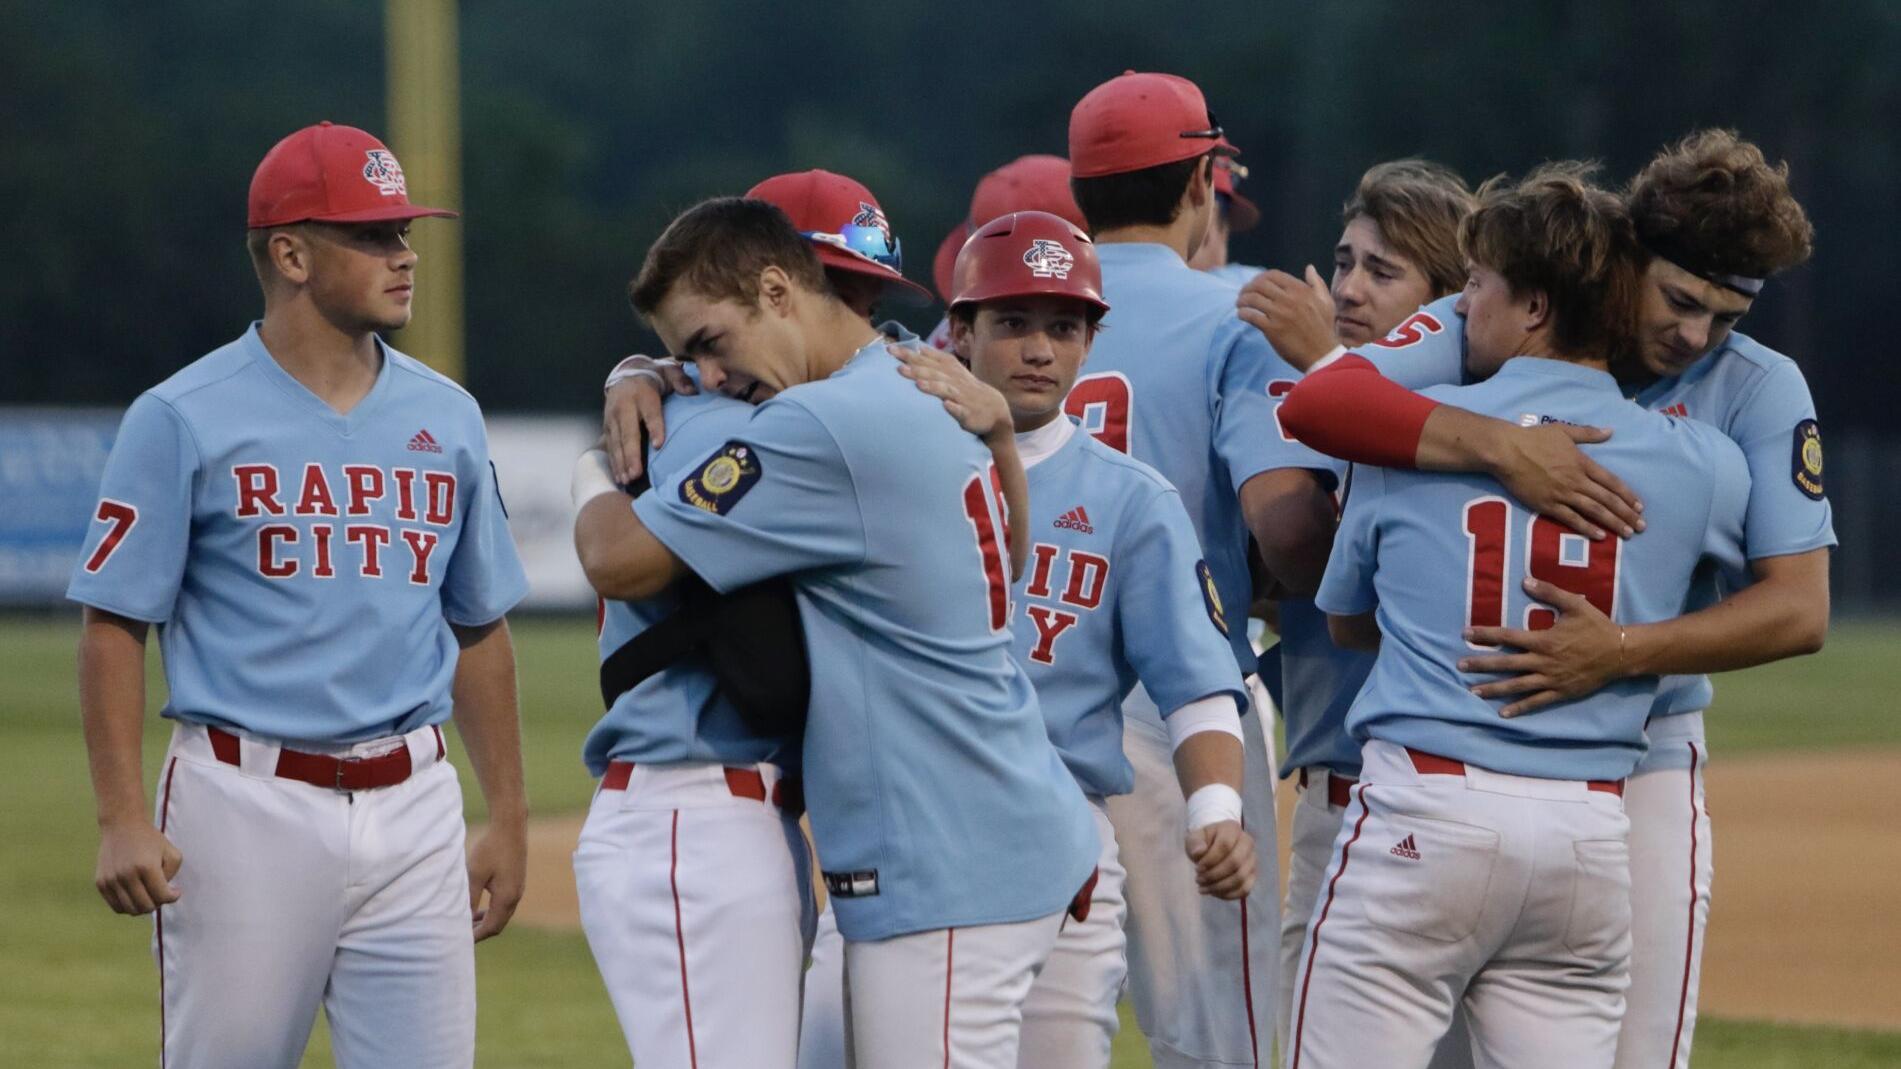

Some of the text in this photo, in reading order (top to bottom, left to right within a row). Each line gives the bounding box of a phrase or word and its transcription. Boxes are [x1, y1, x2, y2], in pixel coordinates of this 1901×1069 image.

[406, 441, 443, 454] adidas
[232, 462, 457, 528] RAPID
[1053, 517, 1093, 536] adidas
[84, 497, 139, 574] 7
[256, 522, 439, 585] CITY
[1462, 495, 1623, 651] 19
[1390, 847, 1421, 861] adidas
